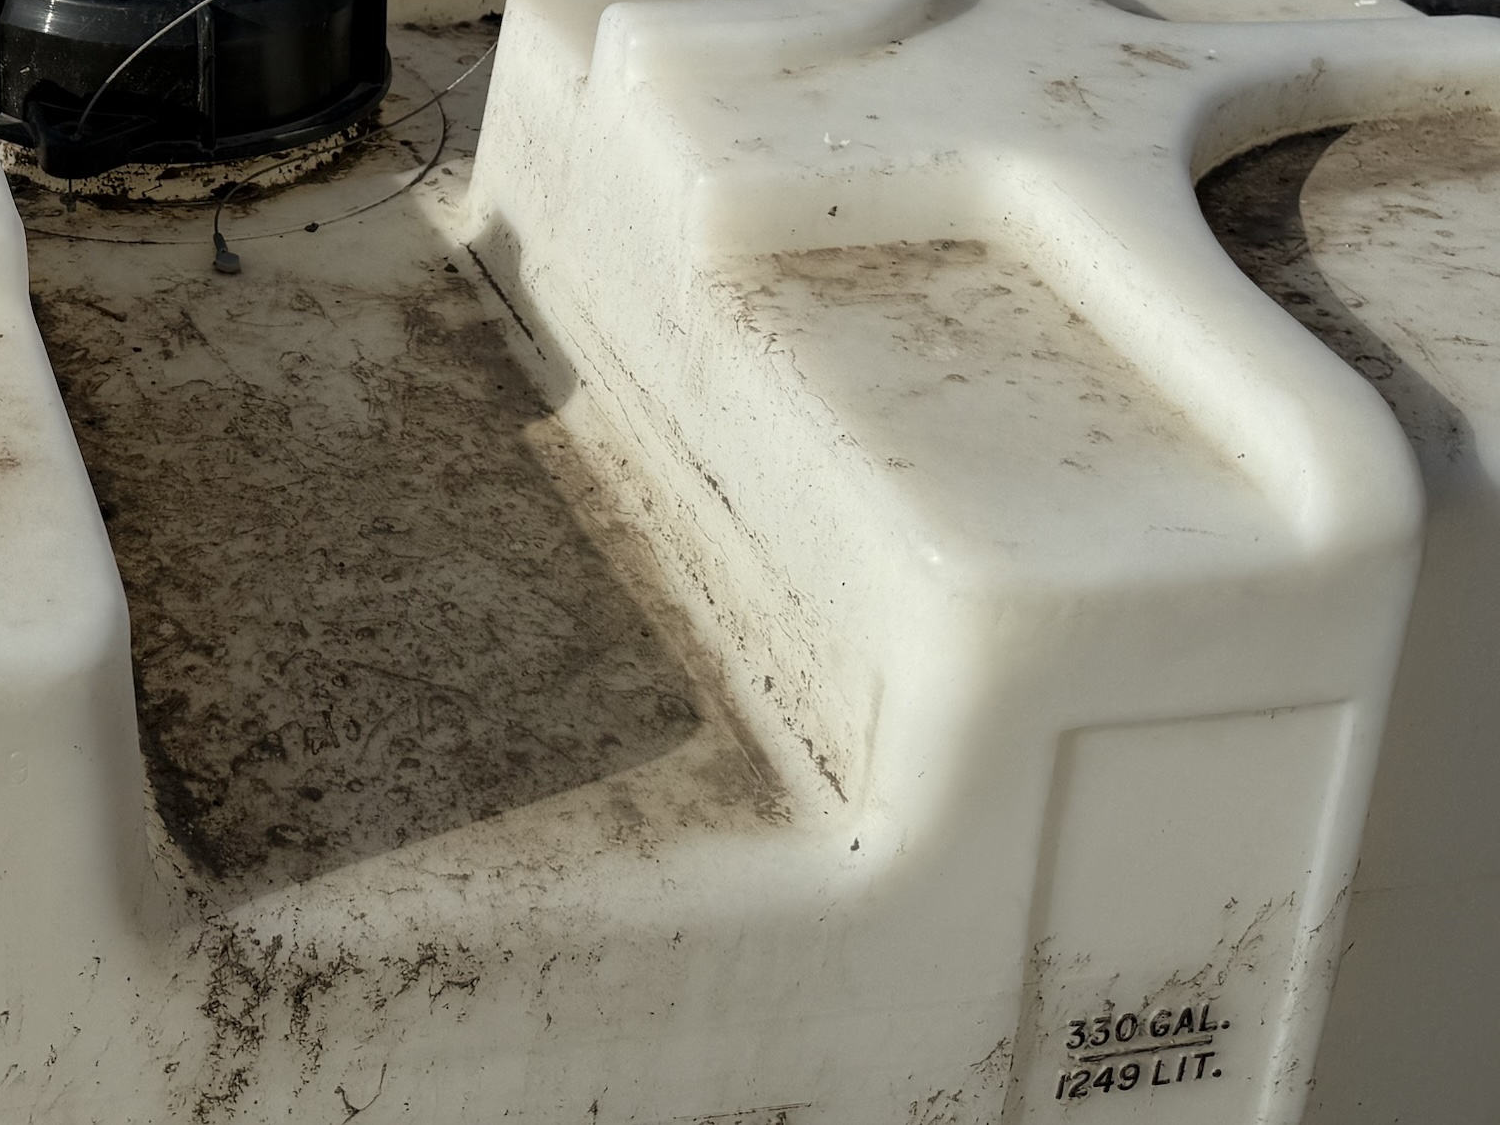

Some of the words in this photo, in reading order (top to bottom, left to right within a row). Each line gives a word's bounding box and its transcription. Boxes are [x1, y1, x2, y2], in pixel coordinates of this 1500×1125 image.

[1064, 1012, 1139, 1050] 330
[1149, 1003, 1231, 1038] GAL.
[1054, 1062, 1141, 1100] 1249
[1150, 1051, 1223, 1087] LIT.
